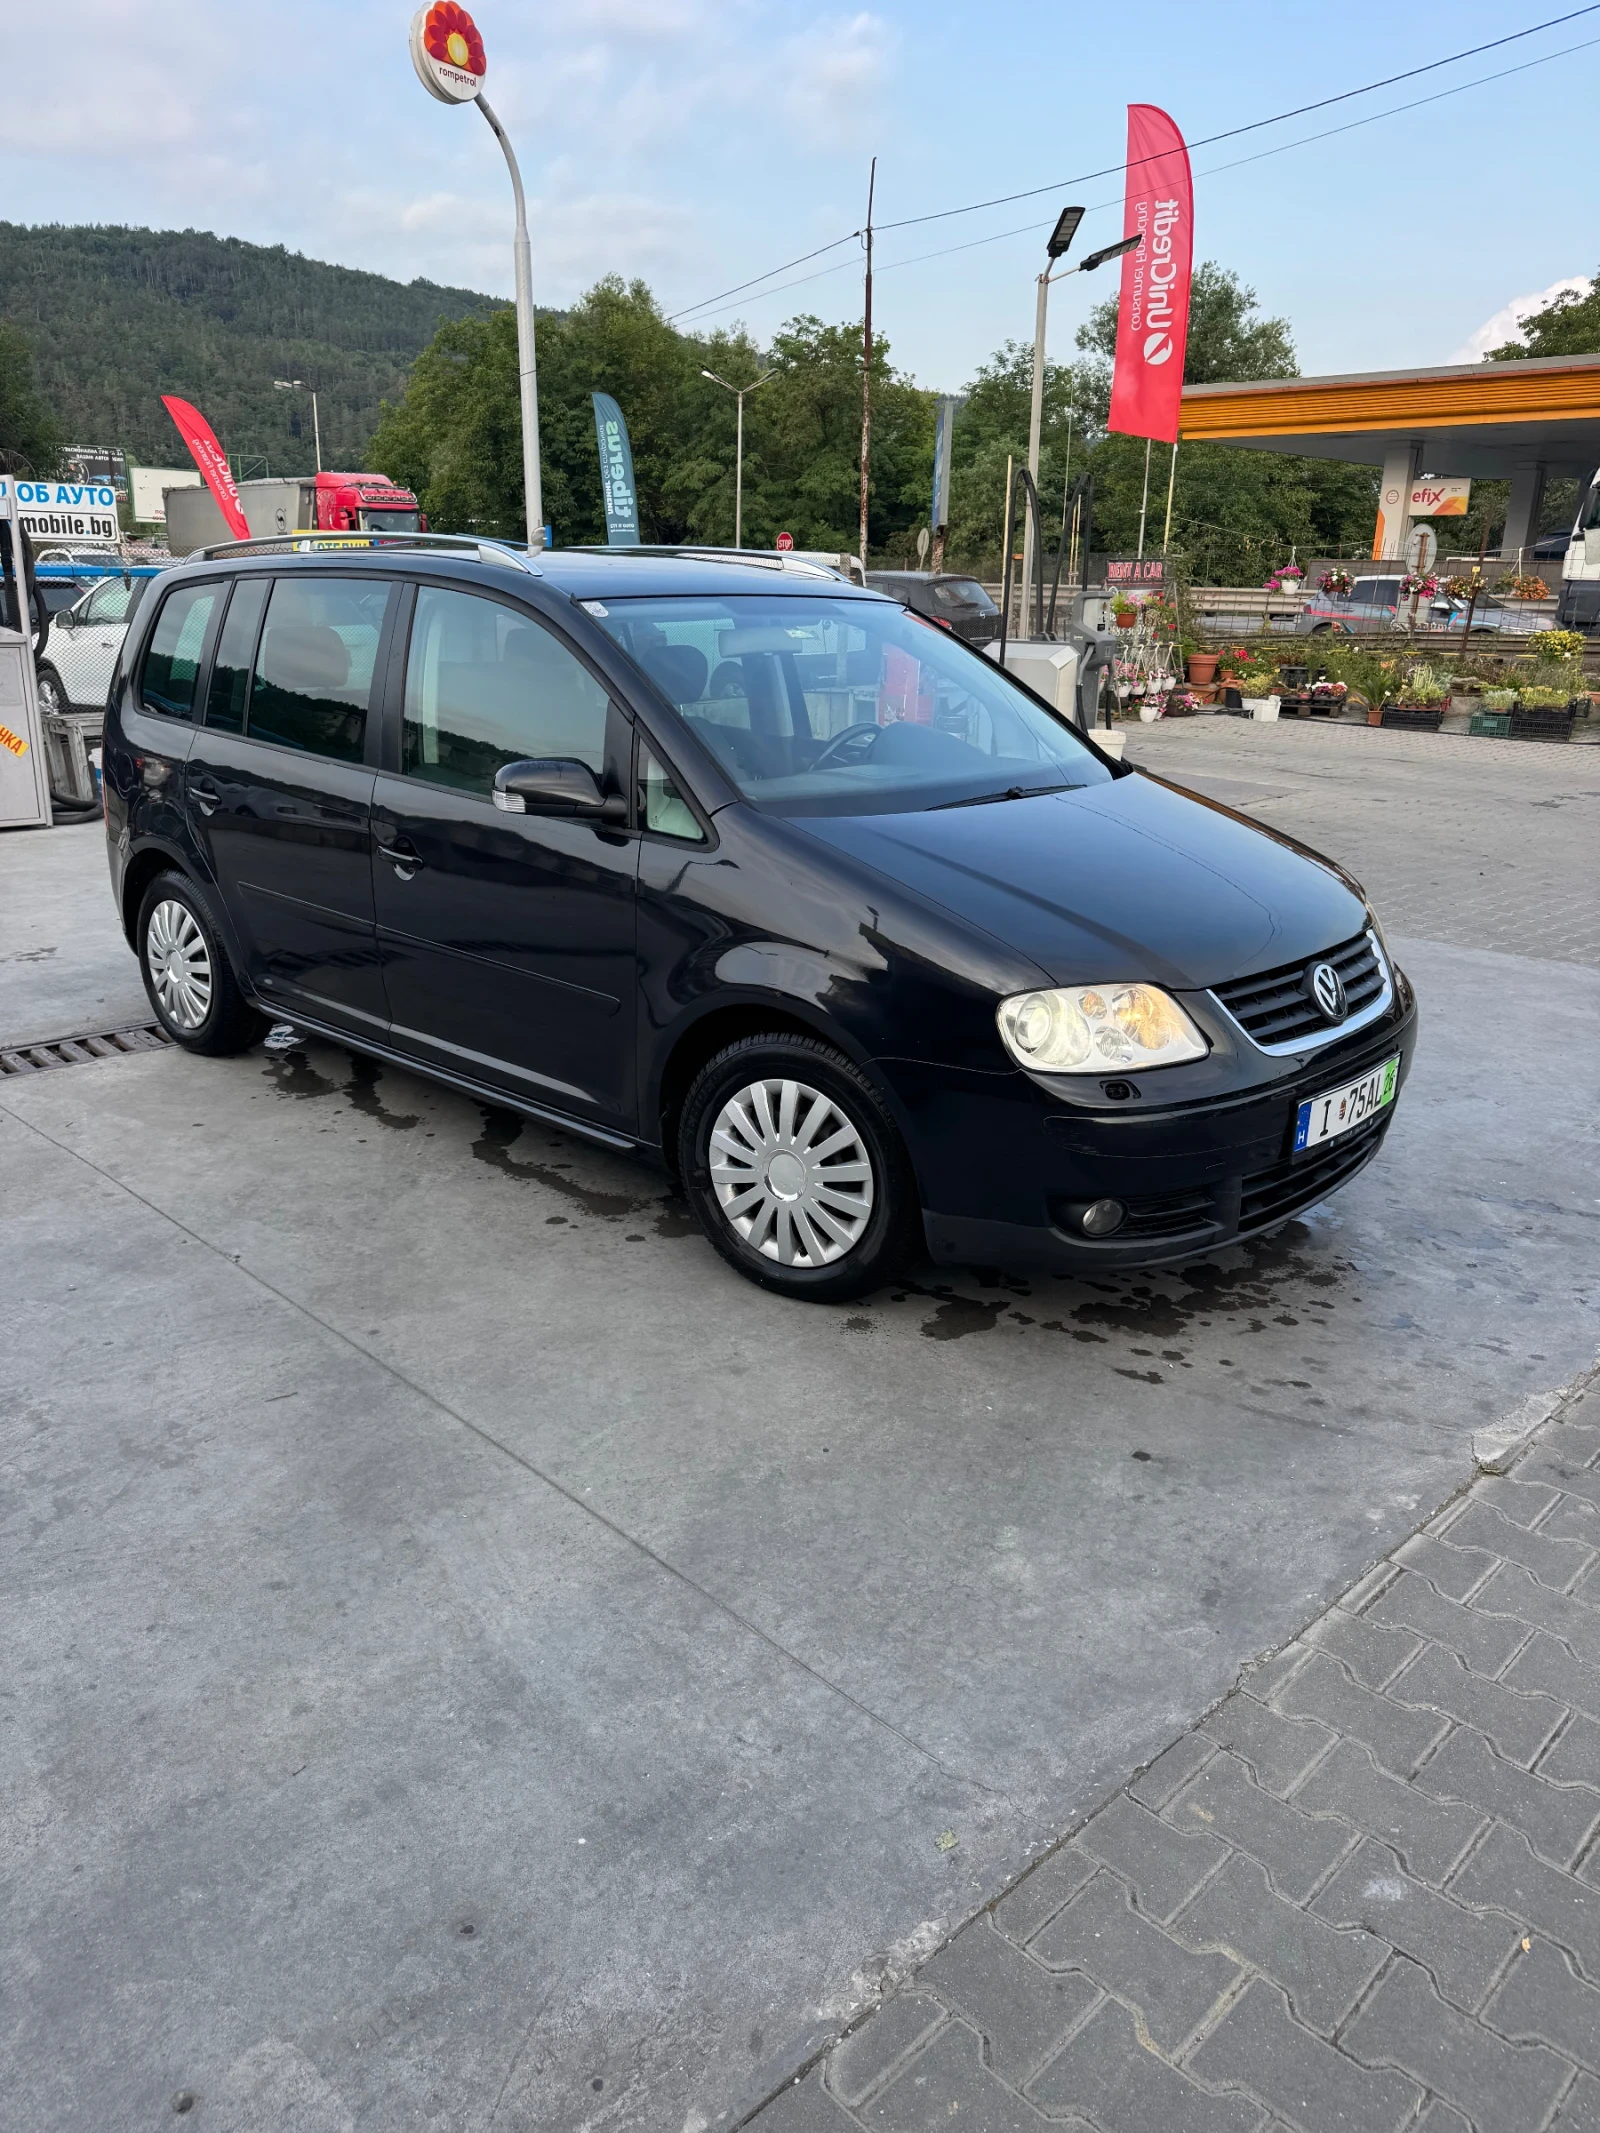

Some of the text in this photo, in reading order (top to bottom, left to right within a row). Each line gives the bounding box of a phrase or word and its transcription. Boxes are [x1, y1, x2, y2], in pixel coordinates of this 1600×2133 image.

[439, 67, 477, 87] rompetrol
[56, 486, 115, 506] АУТО
[1412, 488, 1446, 506] efix
[20, 514, 113, 538] mobile.bg
[778, 539, 792, 549] STOP
[1108, 561, 1163, 578] RENT A CAR
